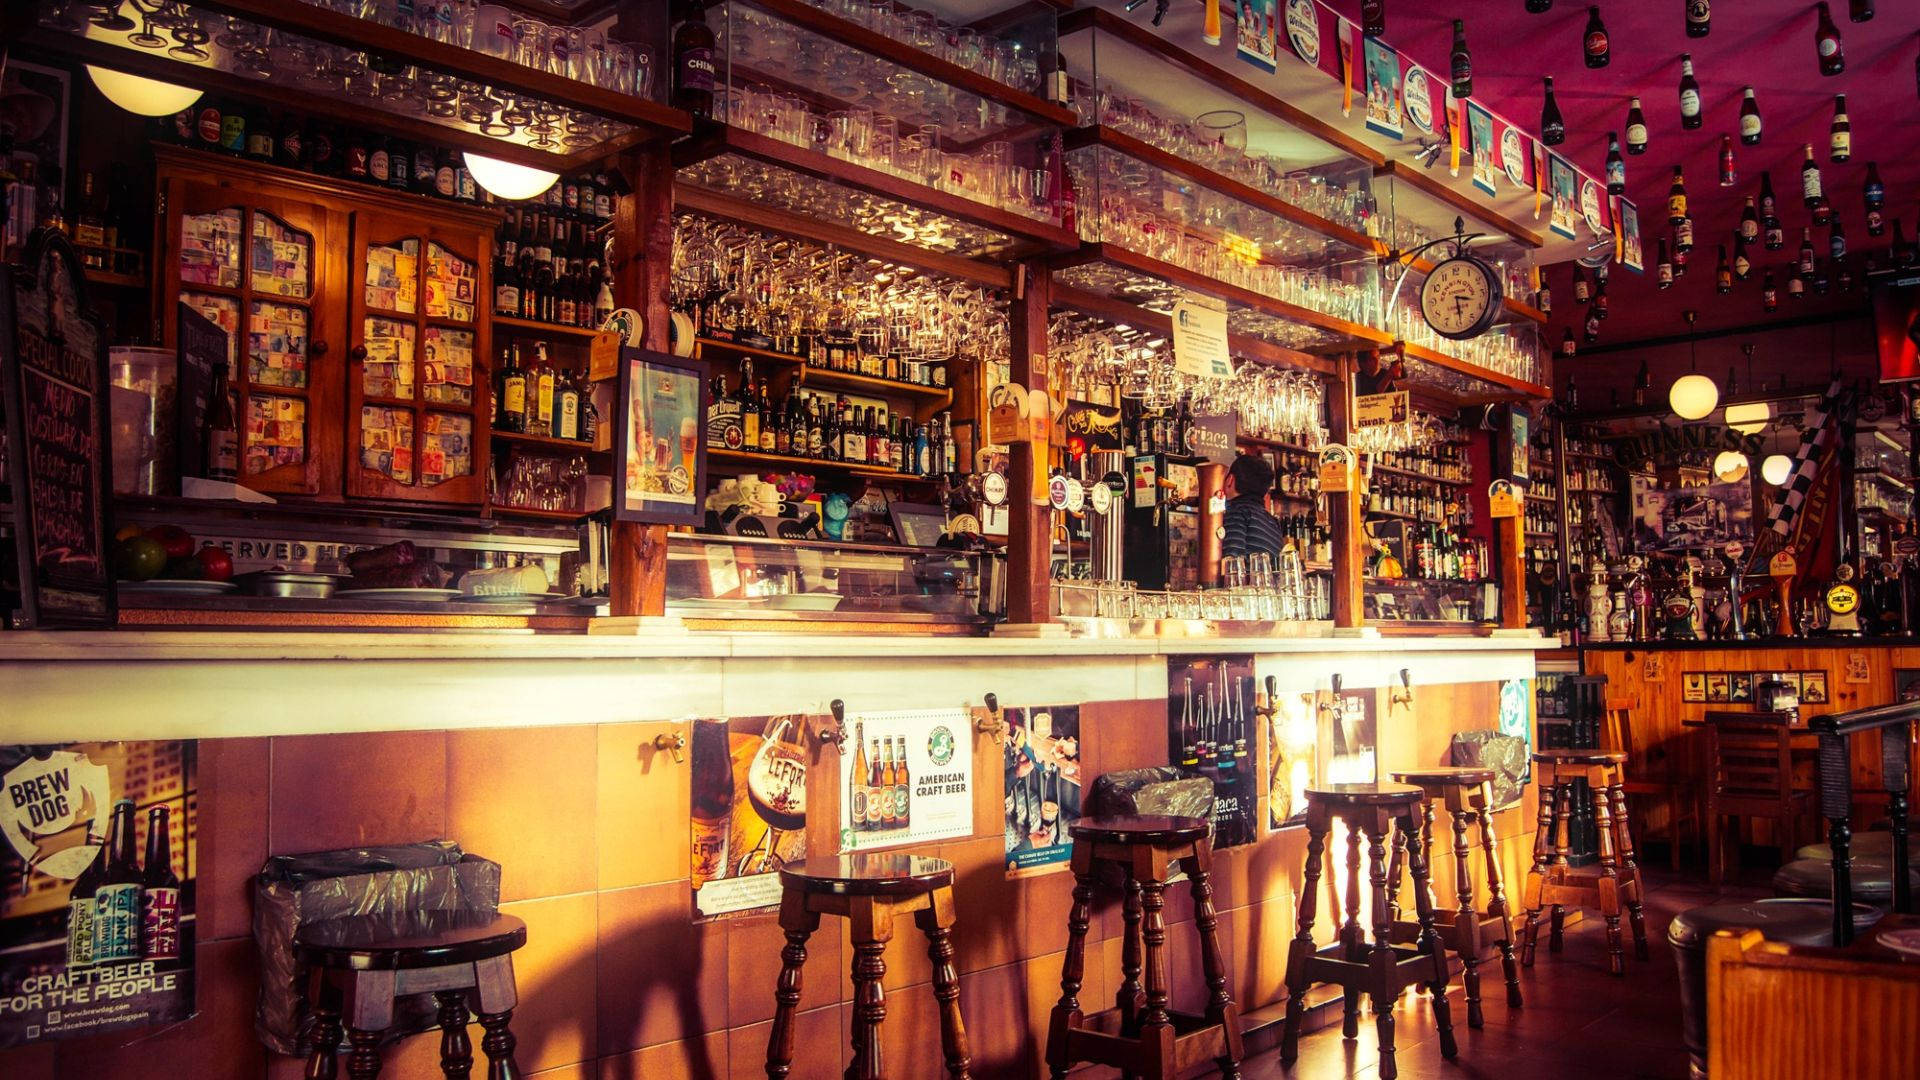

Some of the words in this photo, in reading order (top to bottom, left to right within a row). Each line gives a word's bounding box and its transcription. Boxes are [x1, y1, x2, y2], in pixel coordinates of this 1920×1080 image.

[1614, 424, 1766, 468] GUINNESS
[10, 767, 70, 809] BREW
[916, 785, 944, 797] CRAFT
[945, 783, 967, 794] BEER
[918, 772, 965, 786] AMERICAN
[28, 795, 70, 827] DOG
[693, 837, 726, 858] EFORT
[117, 887, 128, 911] IPA
[77, 902, 86, 931] PONY
[85, 912, 94, 931] ALE
[75, 933, 84, 962] DEAD
[83, 932, 92, 962] PALE
[100, 915, 111, 959] BREWDOG
[115, 914, 127, 957] PUNK
[22, 968, 97, 993] CRAFT
[100, 961, 156, 983] BEER
[0, 993, 43, 1015] FOR
[47, 987, 91, 1008] THE
[95, 975, 177, 1000] PEOPLE
[63, 1002, 131, 1019] www.brewdog.com
